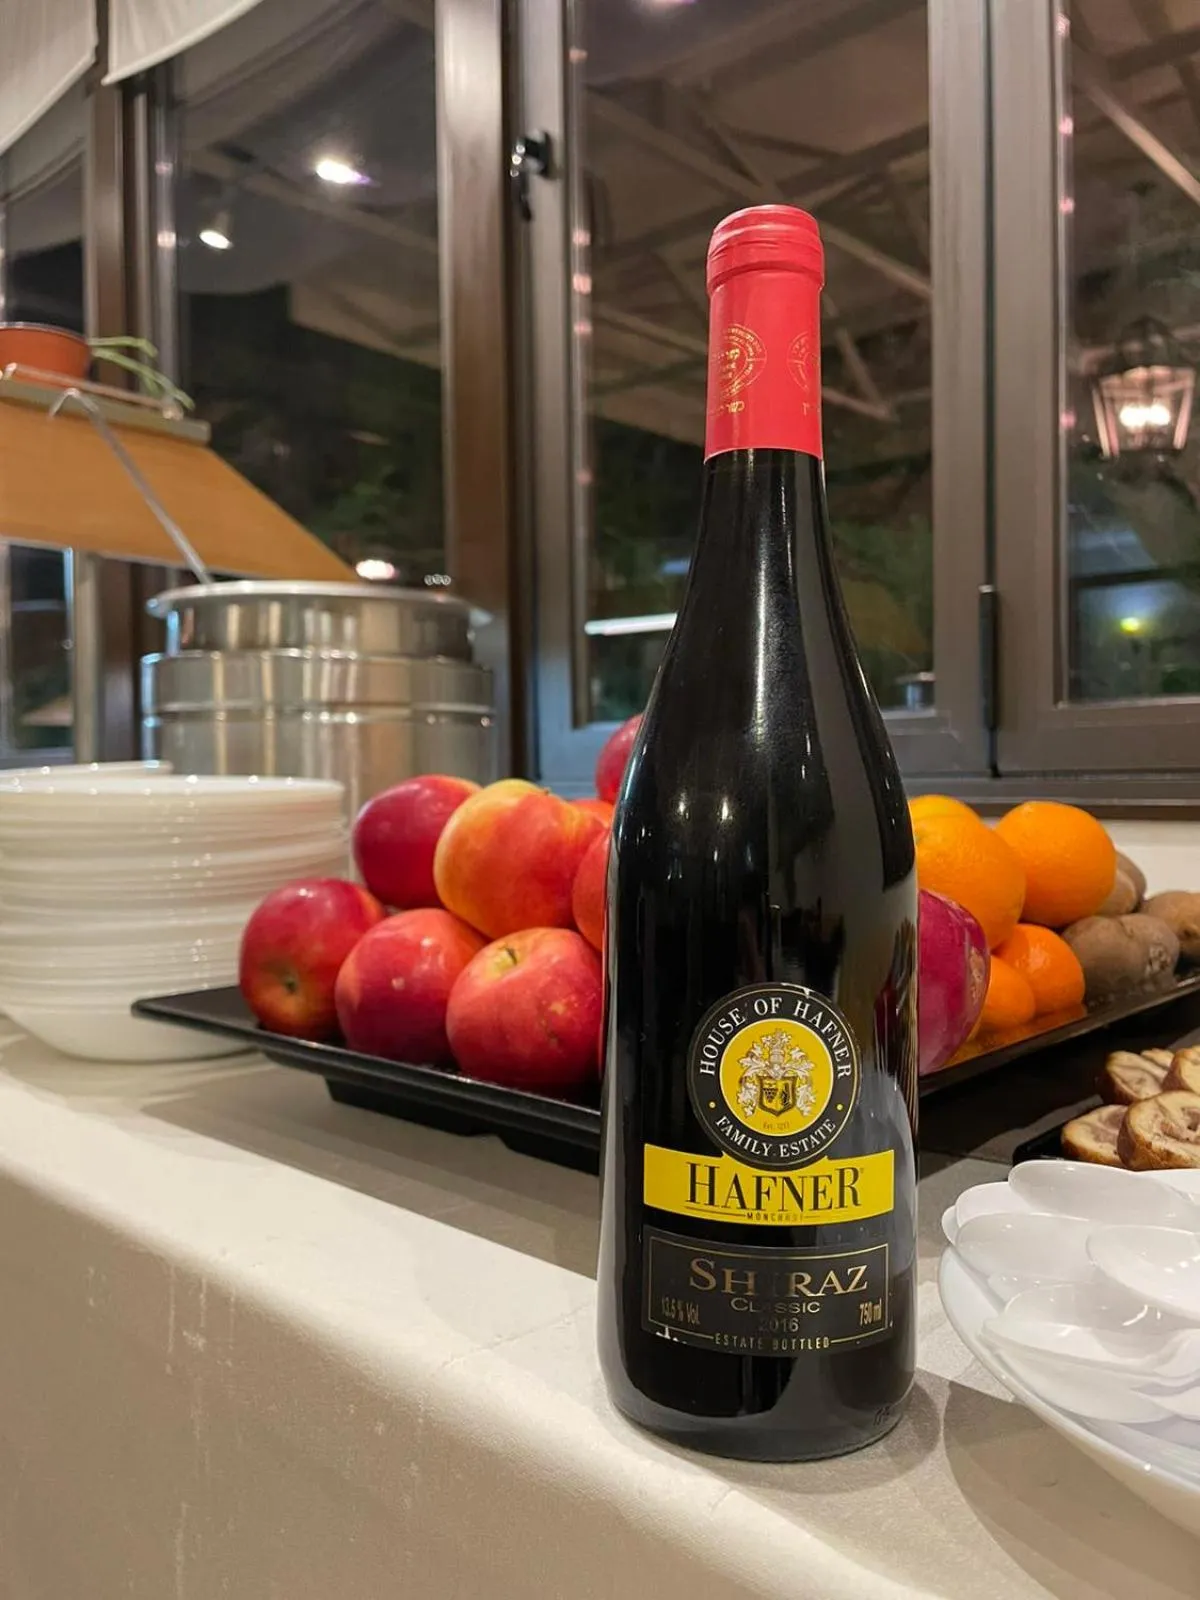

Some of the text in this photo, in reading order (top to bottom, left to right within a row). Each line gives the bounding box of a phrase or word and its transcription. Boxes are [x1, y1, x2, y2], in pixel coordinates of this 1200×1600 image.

[700, 997, 852, 1079] HOUSE OF HAFNER
[715, 1115, 836, 1158] FAMILY ESTATE
[685, 1161, 862, 1213] HAFNER
[730, 1297, 822, 1314] CLSSIC
[859, 1301, 873, 1327] 750
[714, 1332, 763, 1350] ESTATE
